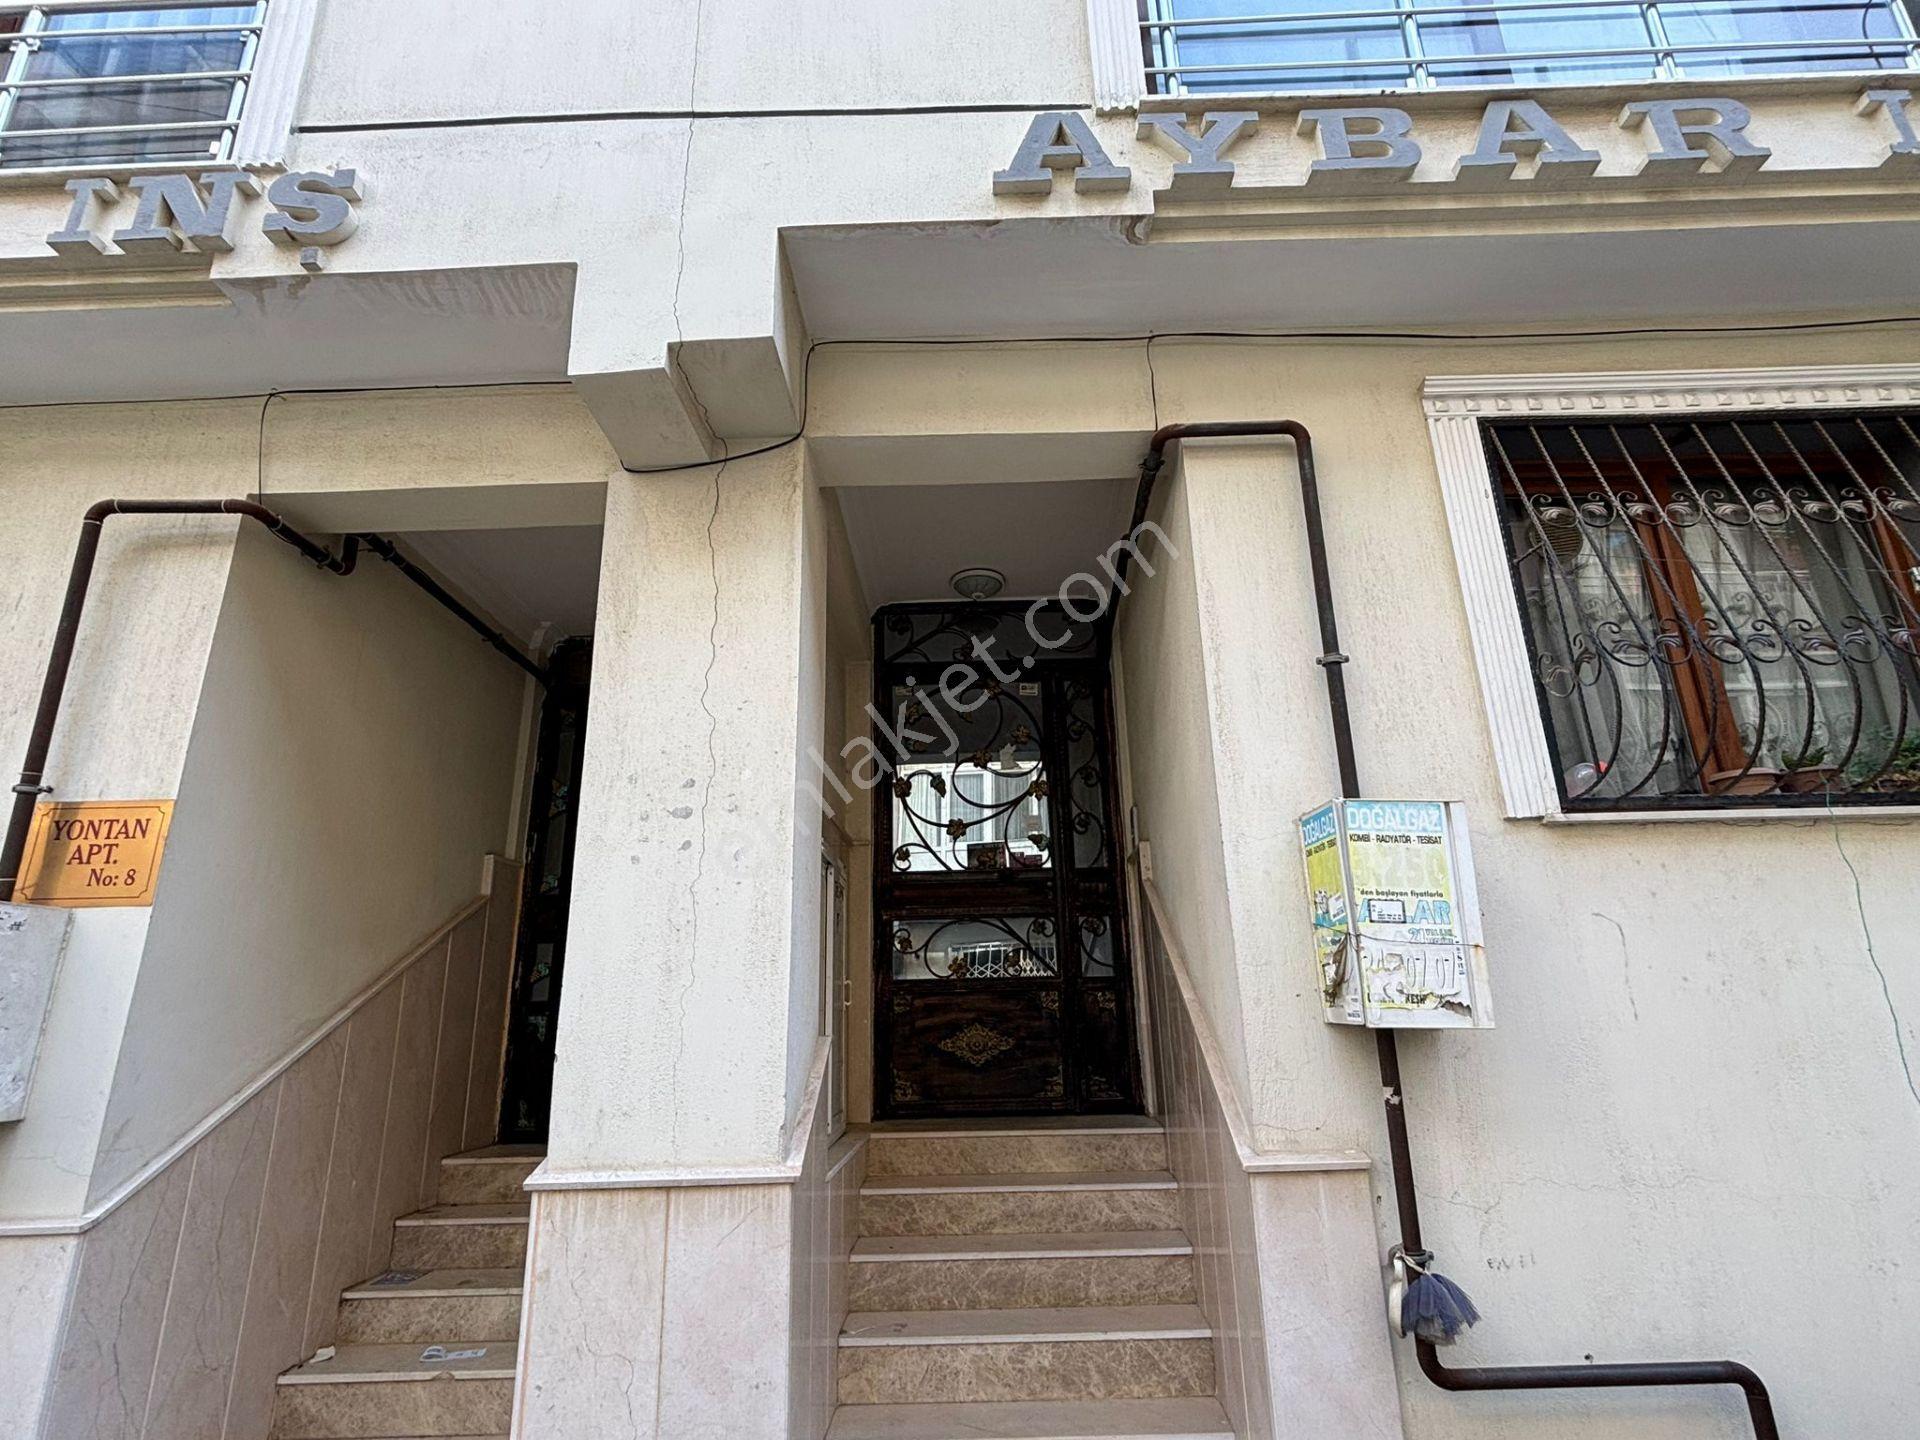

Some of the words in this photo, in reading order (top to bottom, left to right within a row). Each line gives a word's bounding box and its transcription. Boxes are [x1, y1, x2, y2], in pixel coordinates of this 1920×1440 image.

[993, 97, 1772, 194] AYBAR
[1347, 804, 1442, 830] DOĞALGAZ
[52, 818, 151, 841] YONTAN
[1349, 833, 1371, 843] KOMBİ
[1376, 834, 1411, 845] RADYATÖR
[1416, 835, 1442, 845] TESİSAT
[66, 843, 119, 866] APT.
[86, 868, 119, 887] No:
[124, 868, 137, 886] 8
[1375, 889, 1409, 898] başlayan
[1410, 890, 1444, 899] fiyatlarla
